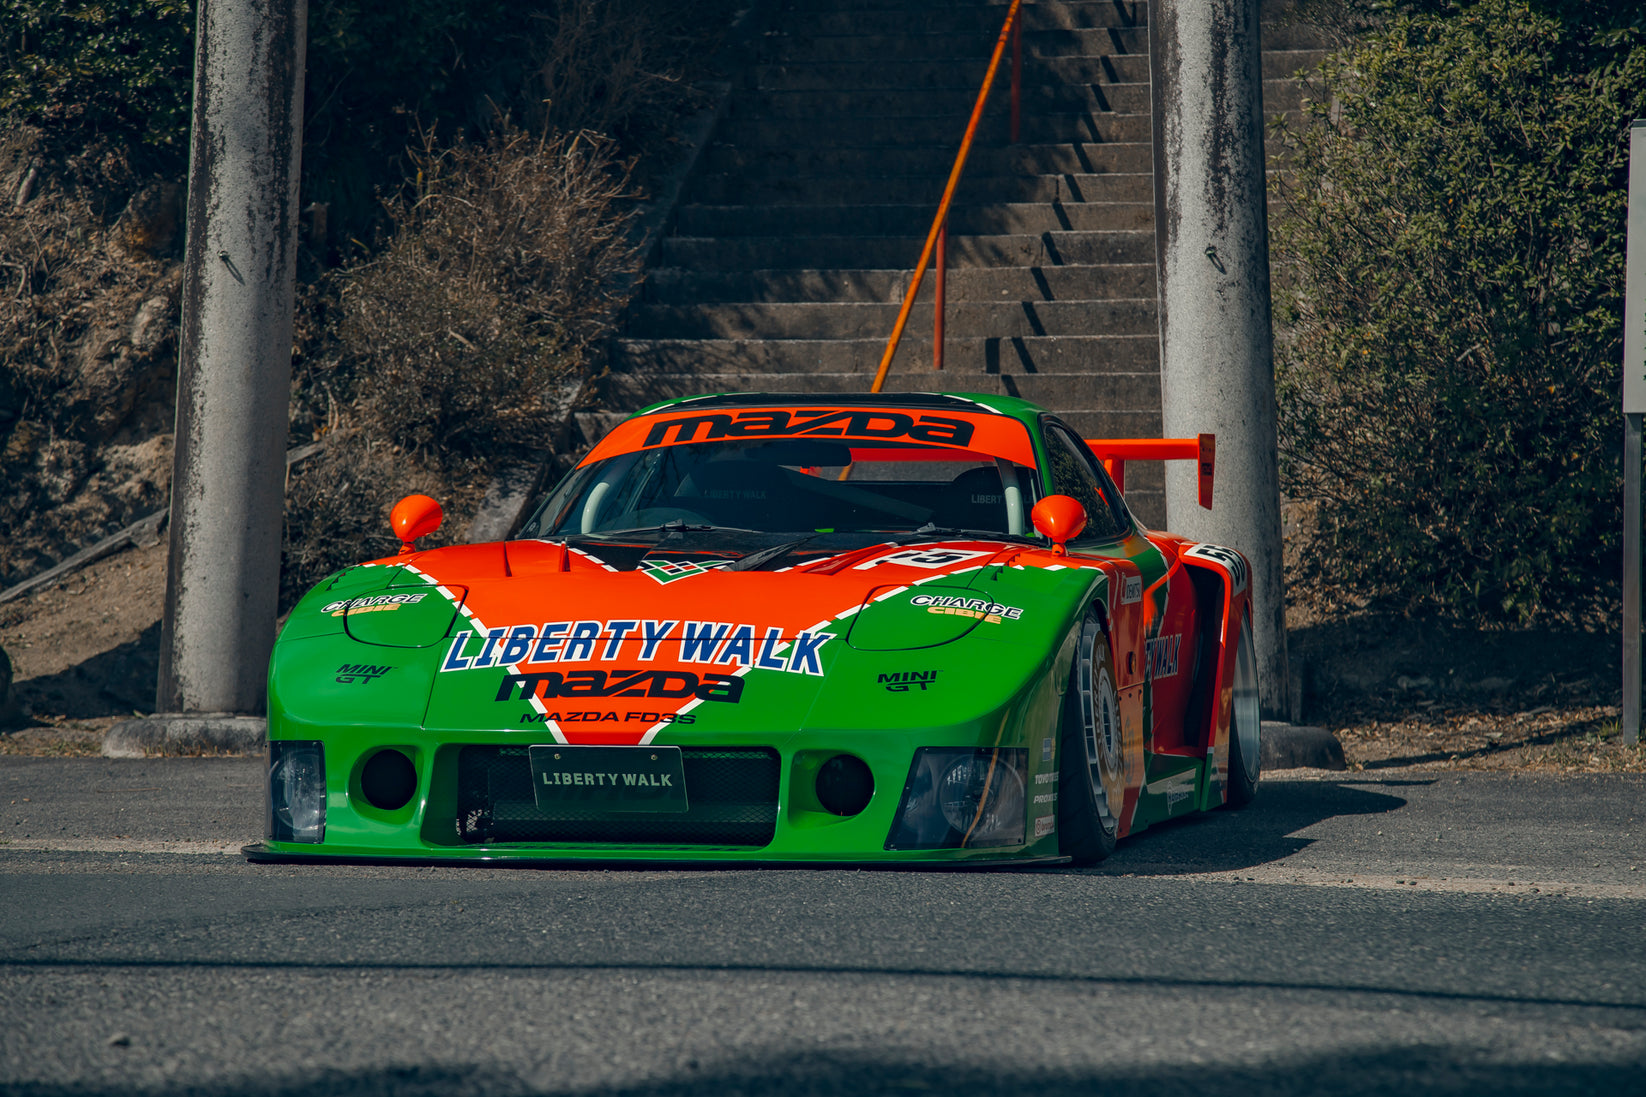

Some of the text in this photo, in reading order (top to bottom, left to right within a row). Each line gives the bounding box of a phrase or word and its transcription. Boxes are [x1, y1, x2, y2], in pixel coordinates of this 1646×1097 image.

[642, 410, 975, 448] mazda
[971, 494, 1003, 504] LIBERT
[321, 593, 428, 613] CHARGE
[910, 594, 1024, 620] CHARGE
[927, 606, 1002, 625] CIBIE
[440, 619, 837, 676] LIBERTY WALK
[1153, 633, 1182, 679] WALK
[336, 664, 392, 675] MINI
[877, 670, 937, 683] MINI
[336, 674, 382, 684] GT
[495, 670, 745, 704] mazda
[885, 680, 936, 692] GT
[520, 712, 696, 724] MAZDA FD3S
[542, 772, 673, 787] LIBERTY WALK
